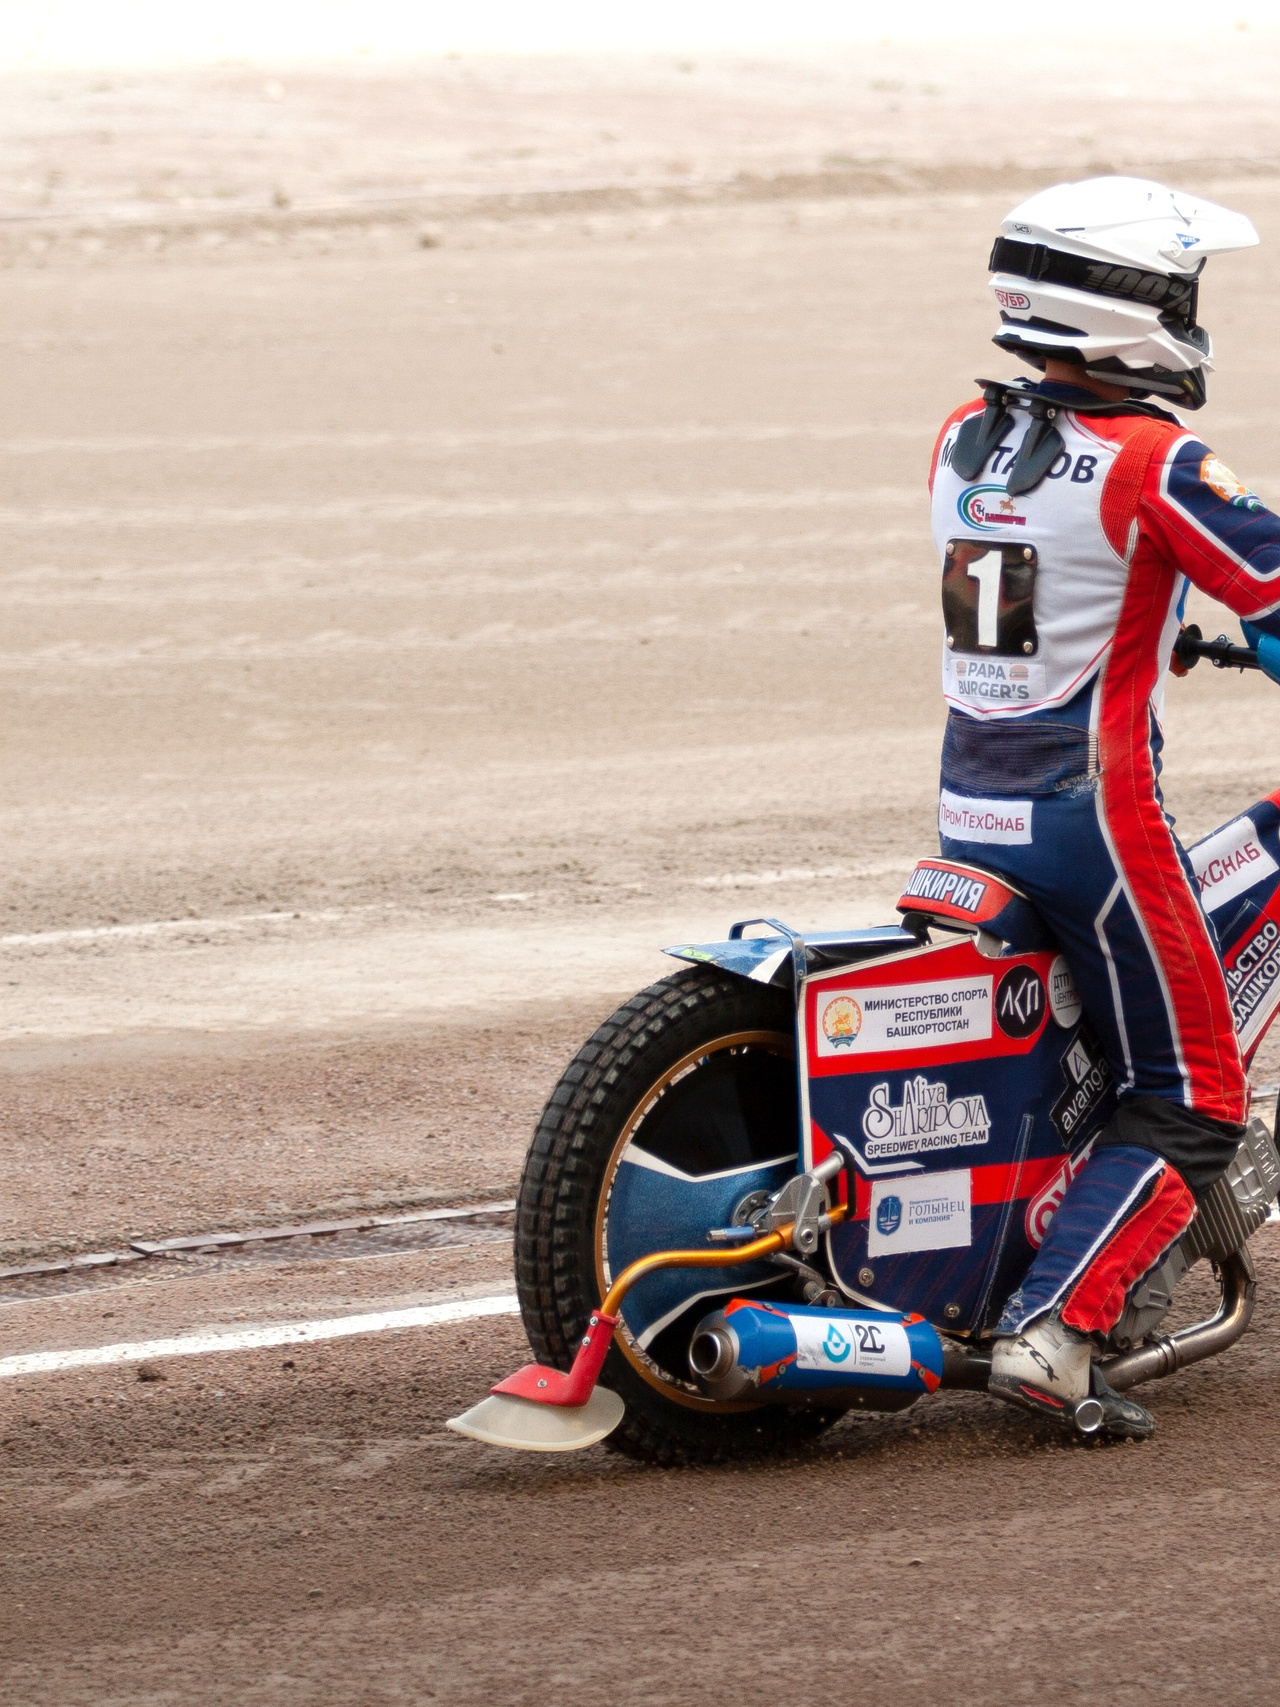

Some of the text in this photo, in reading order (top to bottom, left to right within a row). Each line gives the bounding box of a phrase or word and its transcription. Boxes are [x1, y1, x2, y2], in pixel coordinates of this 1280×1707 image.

[1082, 264, 1193, 315] 100%
[967, 550, 1003, 648] 1
[968, 661, 1007, 680] PAPA
[958, 680, 1030, 700] BURGER'S
[864, 988, 988, 1012] МИНИСТЕРСТВО СПОРТА
[894, 1005, 963, 1023] РЕСПУБЛИКИ
[886, 1019, 970, 1038] БАШКОРТОСТАН
[867, 1129, 987, 1156] SPEEDWEY RACING TEAM
[908, 1200, 966, 1217] ГОЛЫНЕЦ
